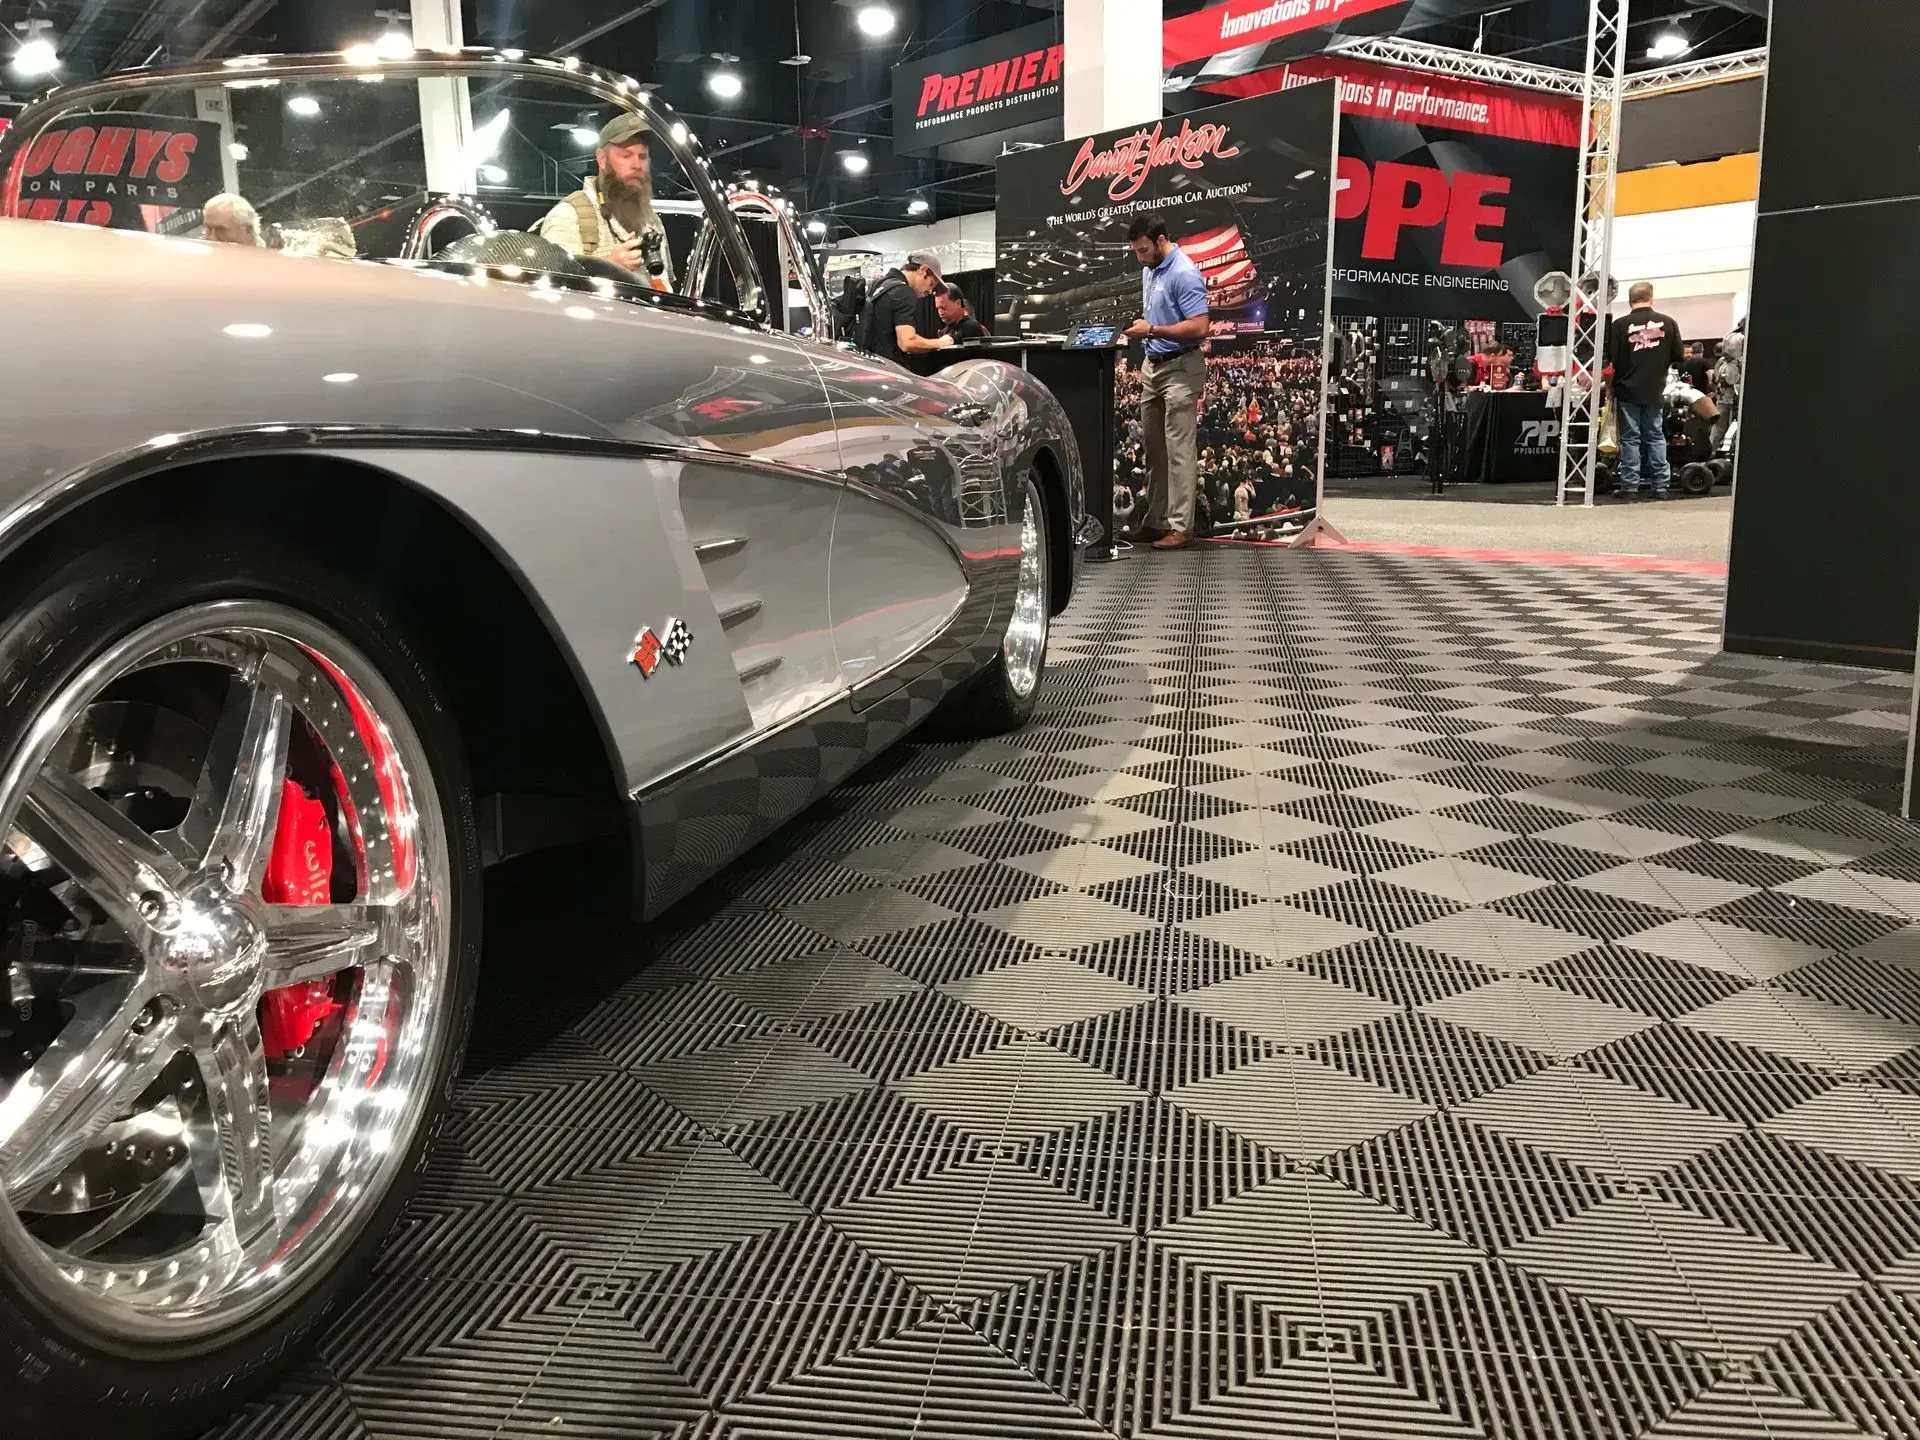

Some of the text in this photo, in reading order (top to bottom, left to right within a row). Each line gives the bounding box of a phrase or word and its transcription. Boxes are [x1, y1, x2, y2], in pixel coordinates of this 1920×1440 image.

[1220, 0, 1310, 39] Innovations
[917, 43, 1064, 117] PREMIER
[916, 109, 964, 130] PERFORMANCE
[966, 100, 1003, 117] PRODUCTS
[1376, 81, 1392, 107] in
[1393, 86, 1489, 123] performance.
[1060, 118, 1239, 201] Barrett-Jackson
[86, 180, 179, 199] PARTS
[1047, 215, 1064, 226] THE
[1065, 208, 1096, 223] WORLD'S
[1098, 203, 1135, 218] GREATEST
[1136, 196, 1183, 211] COLLECTOR
[1185, 191, 1203, 204] CAR
[1424, 274, 1509, 291] ENGINEERING
